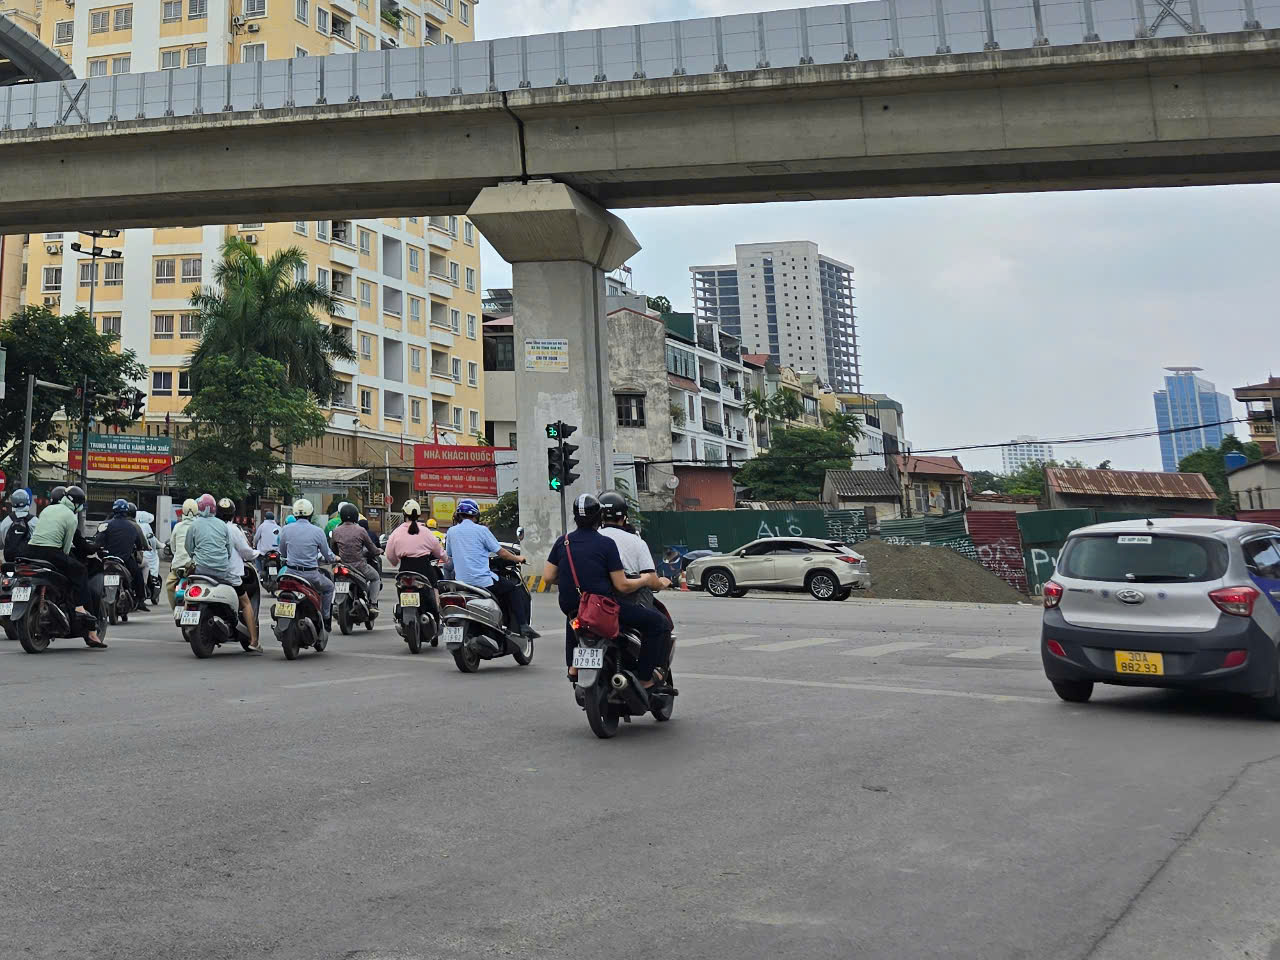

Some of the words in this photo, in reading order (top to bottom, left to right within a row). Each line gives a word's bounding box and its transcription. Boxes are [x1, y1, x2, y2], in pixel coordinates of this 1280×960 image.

[424, 449, 441, 460] NHÀ
[442, 450, 469, 461] KHÁCH
[470, 450, 491, 461] QUỐC
[574, 657, 601, 667] 029.64
[1128, 652, 1148, 662] 30A
[1121, 662, 1158, 673] 882.93
